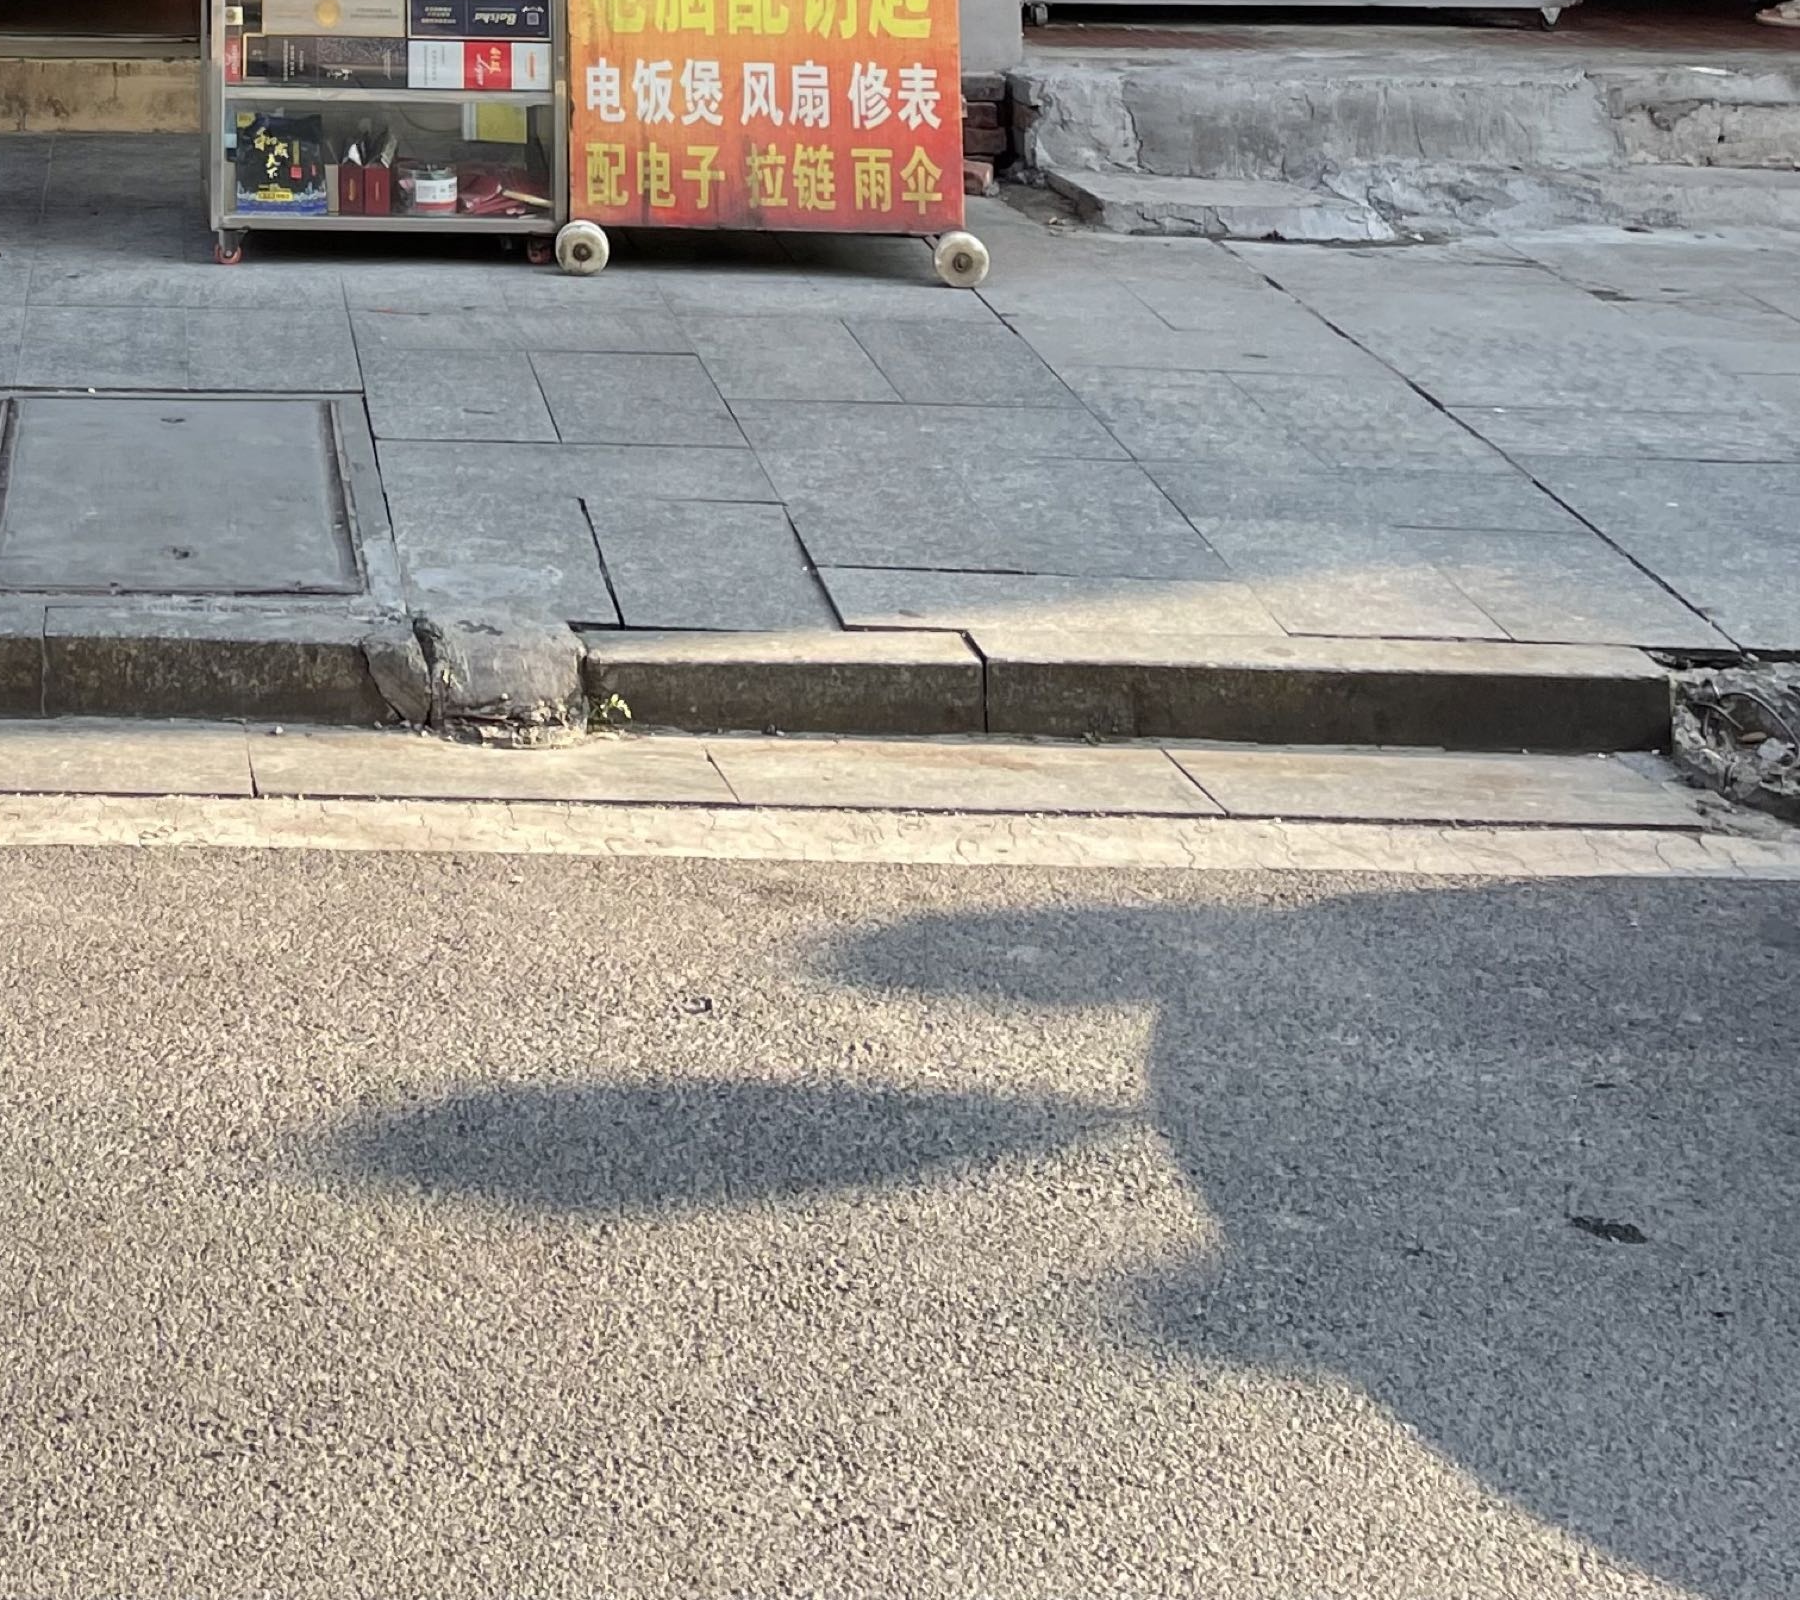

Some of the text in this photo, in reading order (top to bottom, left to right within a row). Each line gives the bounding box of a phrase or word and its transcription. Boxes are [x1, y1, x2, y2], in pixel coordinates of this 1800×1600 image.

[585, 56, 942, 130] 电饭煲 风扇 修表
[586, 141, 944, 213] 配电子 拉链 雨伞
